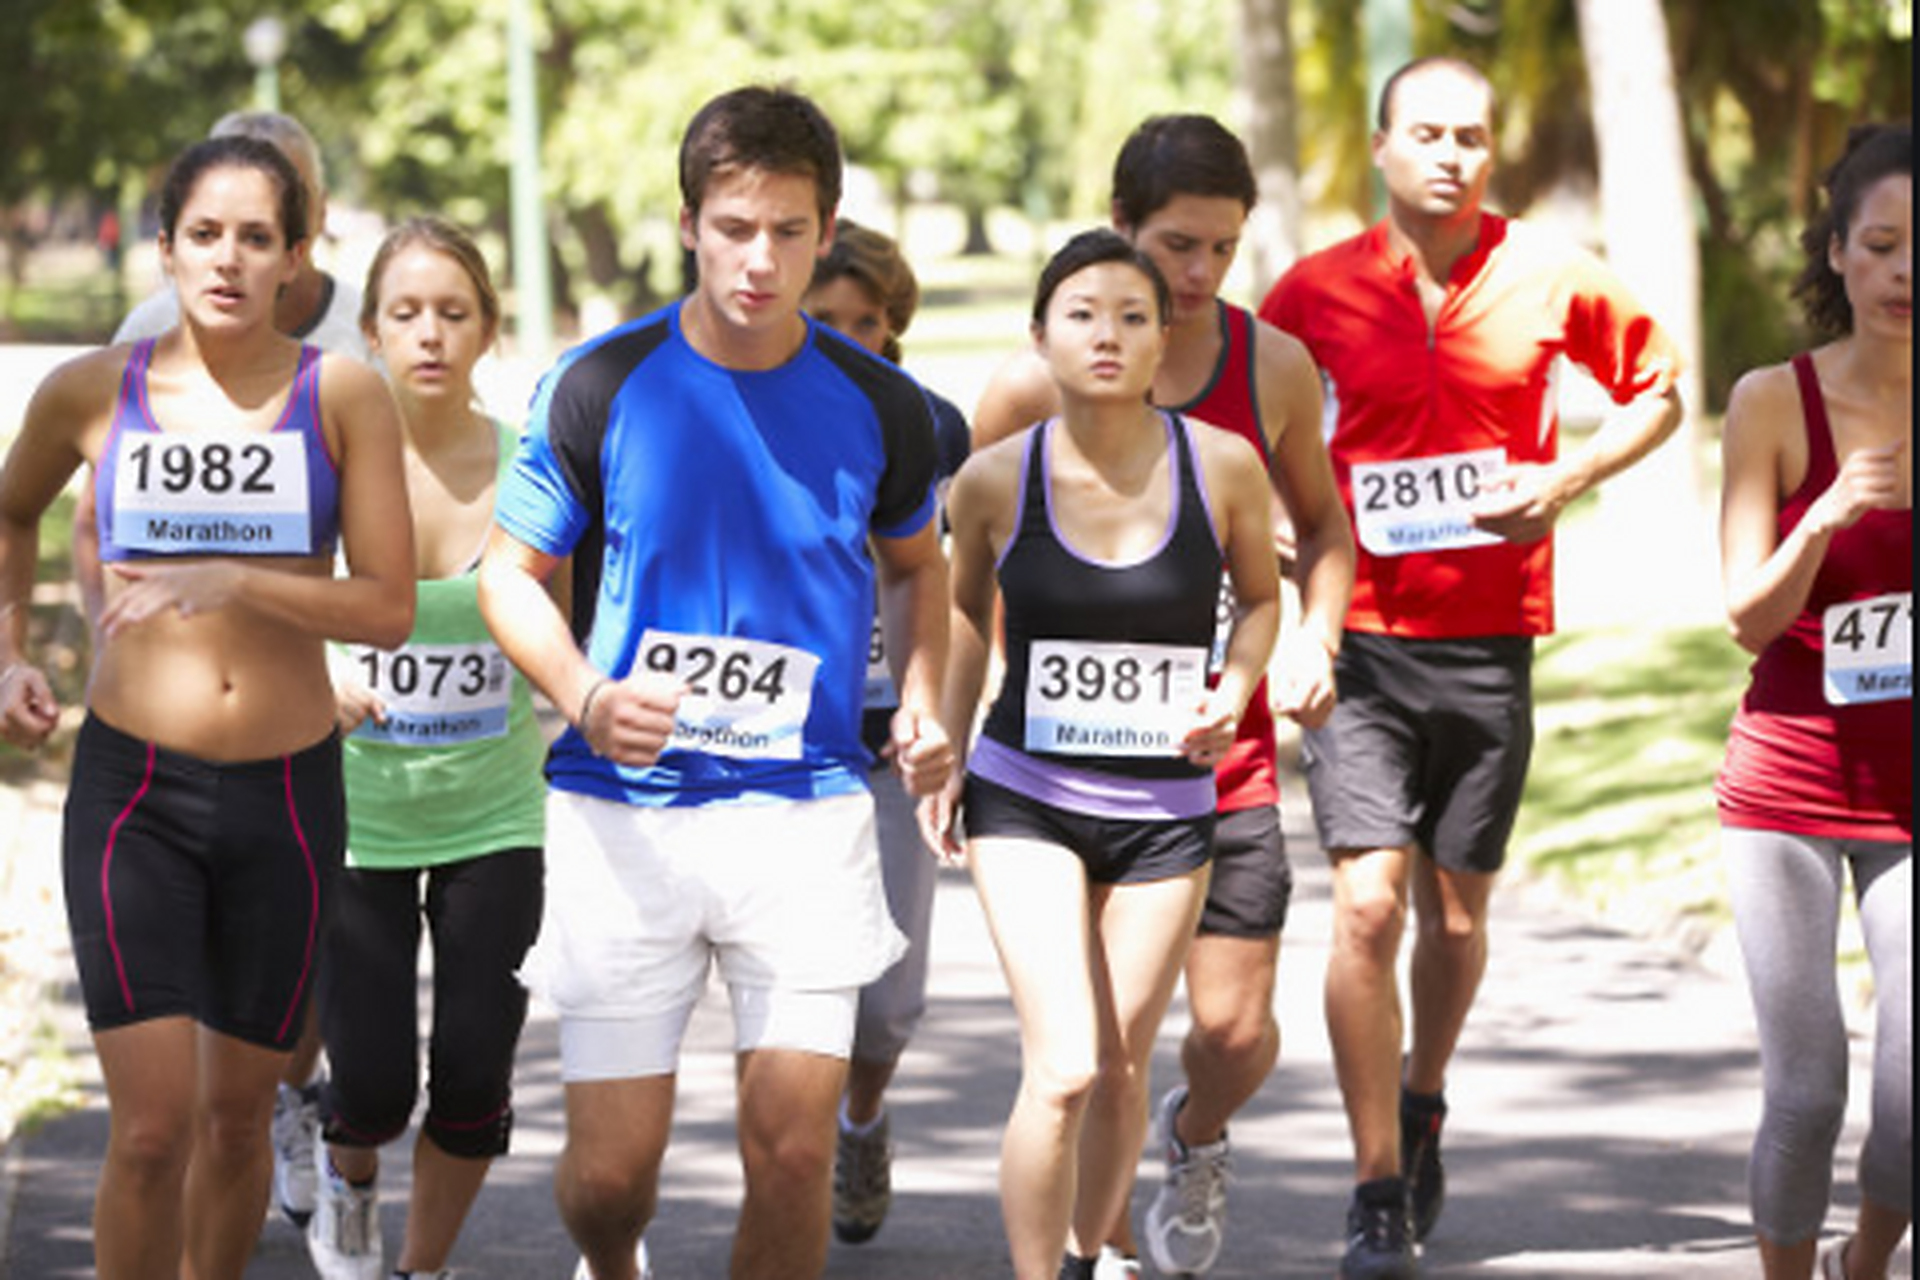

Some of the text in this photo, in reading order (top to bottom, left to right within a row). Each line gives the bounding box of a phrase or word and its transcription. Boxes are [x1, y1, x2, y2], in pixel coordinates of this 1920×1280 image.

[130, 443, 275, 494] 1982
[1362, 462, 1480, 512] 2810
[147, 519, 273, 542] Marathon
[360, 652, 486, 697] 1073
[1039, 654, 1172, 704] 3981
[675, 720, 769, 748] arathon
[1056, 724, 1170, 748] Marathon
